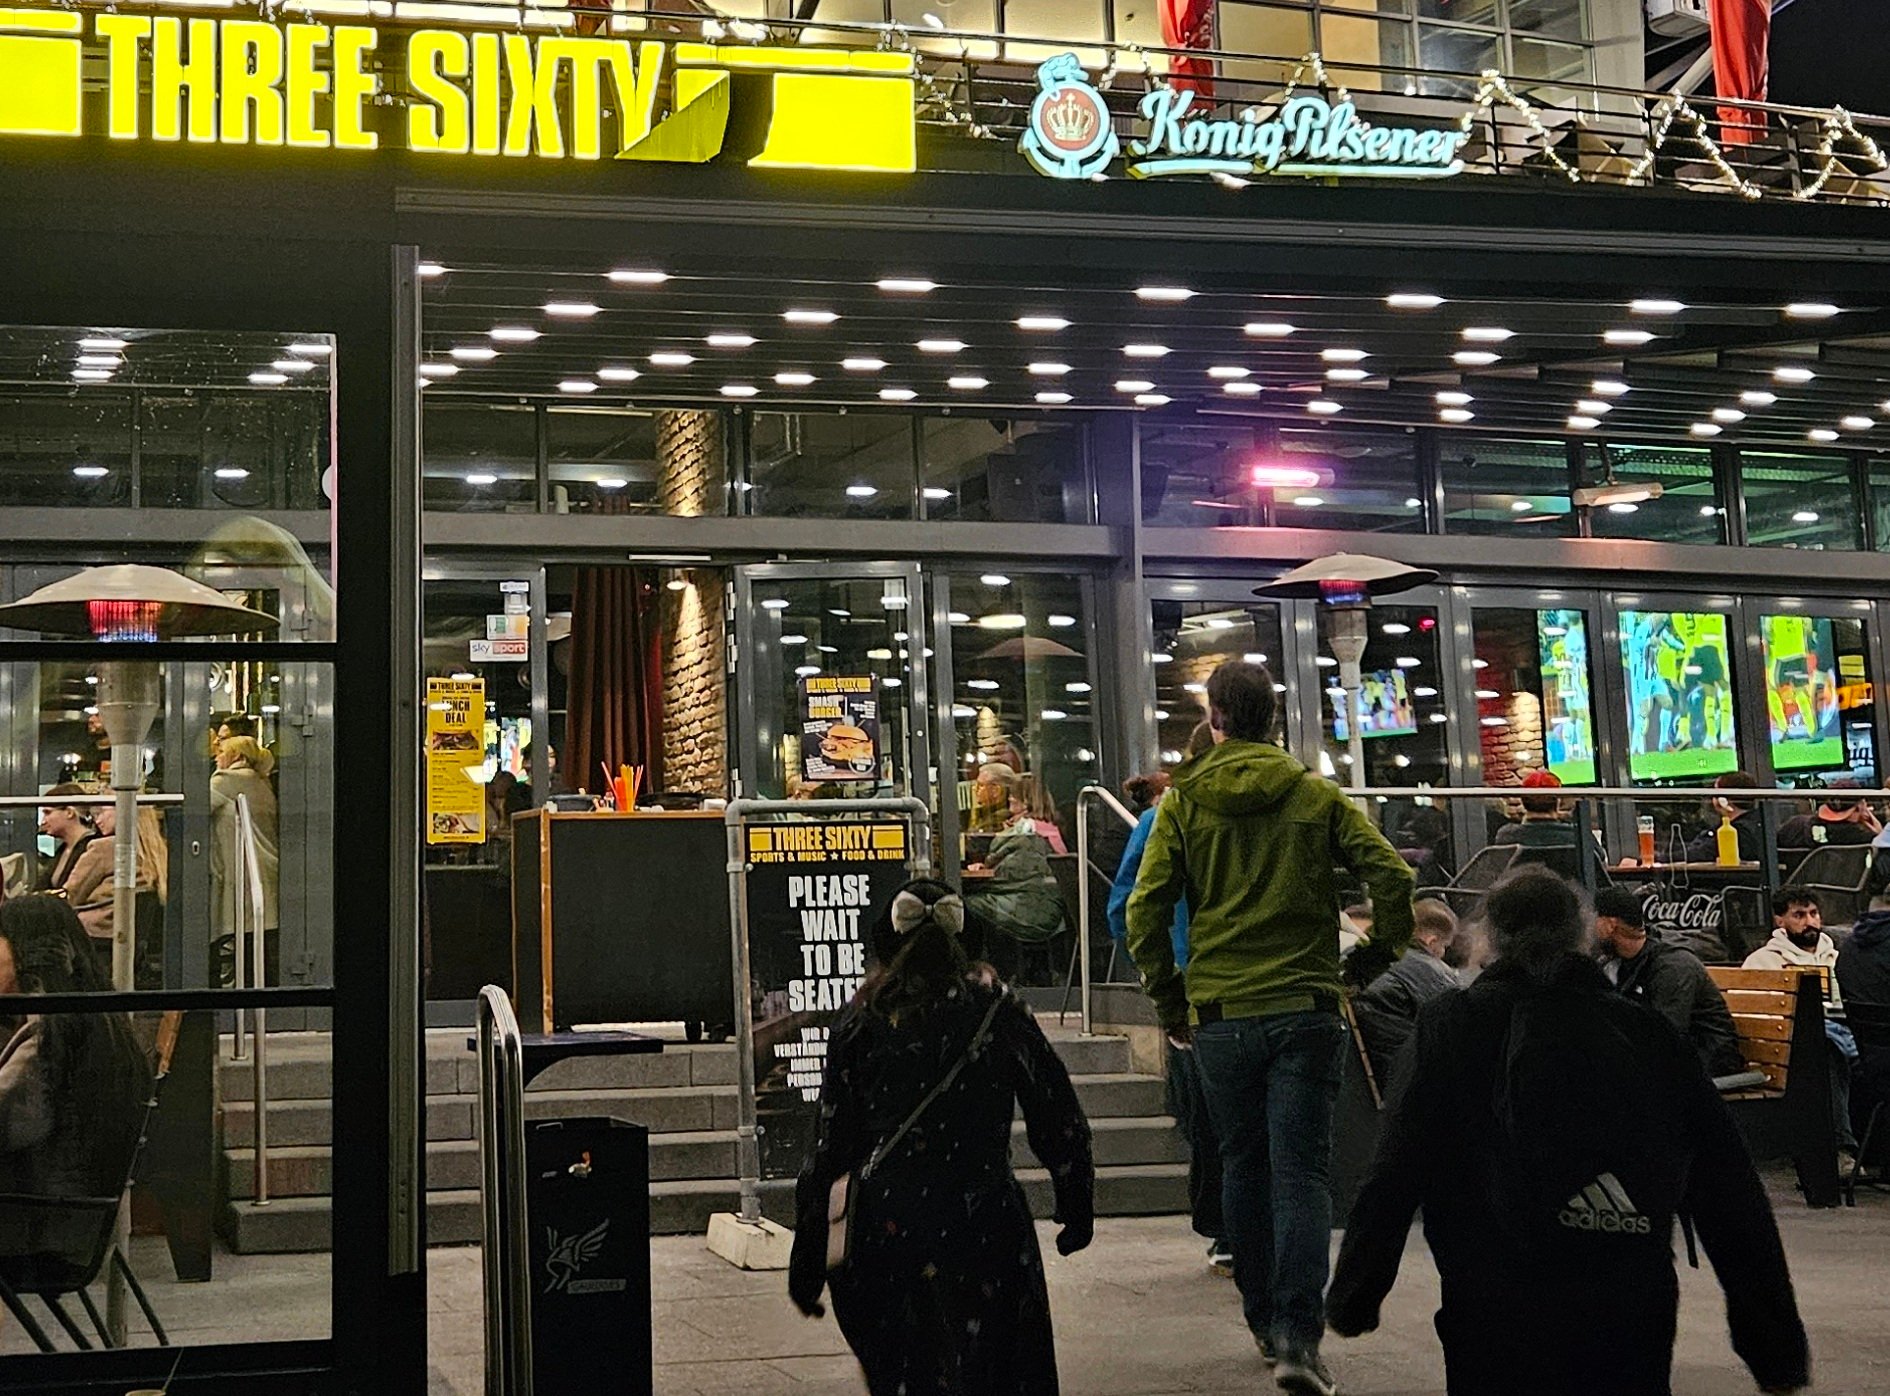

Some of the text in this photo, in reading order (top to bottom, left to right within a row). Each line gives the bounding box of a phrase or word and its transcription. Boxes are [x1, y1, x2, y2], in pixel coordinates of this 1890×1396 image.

[94, 14, 666, 160] THREE SIXTY
[1281, 96, 1467, 164] Pilsener
[472, 643, 525, 654] sky sport
[445, 712, 466, 723] DEAL
[773, 825, 871, 851] THREE SIXTY
[750, 849, 905, 863] SPORTS & MUSIC FOOD & DRINK
[788, 874, 871, 908] PLEASE
[800, 908, 861, 942] WAIT
[1641, 894, 1723, 928] Coca-Cola
[800, 942, 866, 976] TO BE
[788, 976, 868, 1013] SEATE
[1558, 1206, 1652, 1234] adidas
